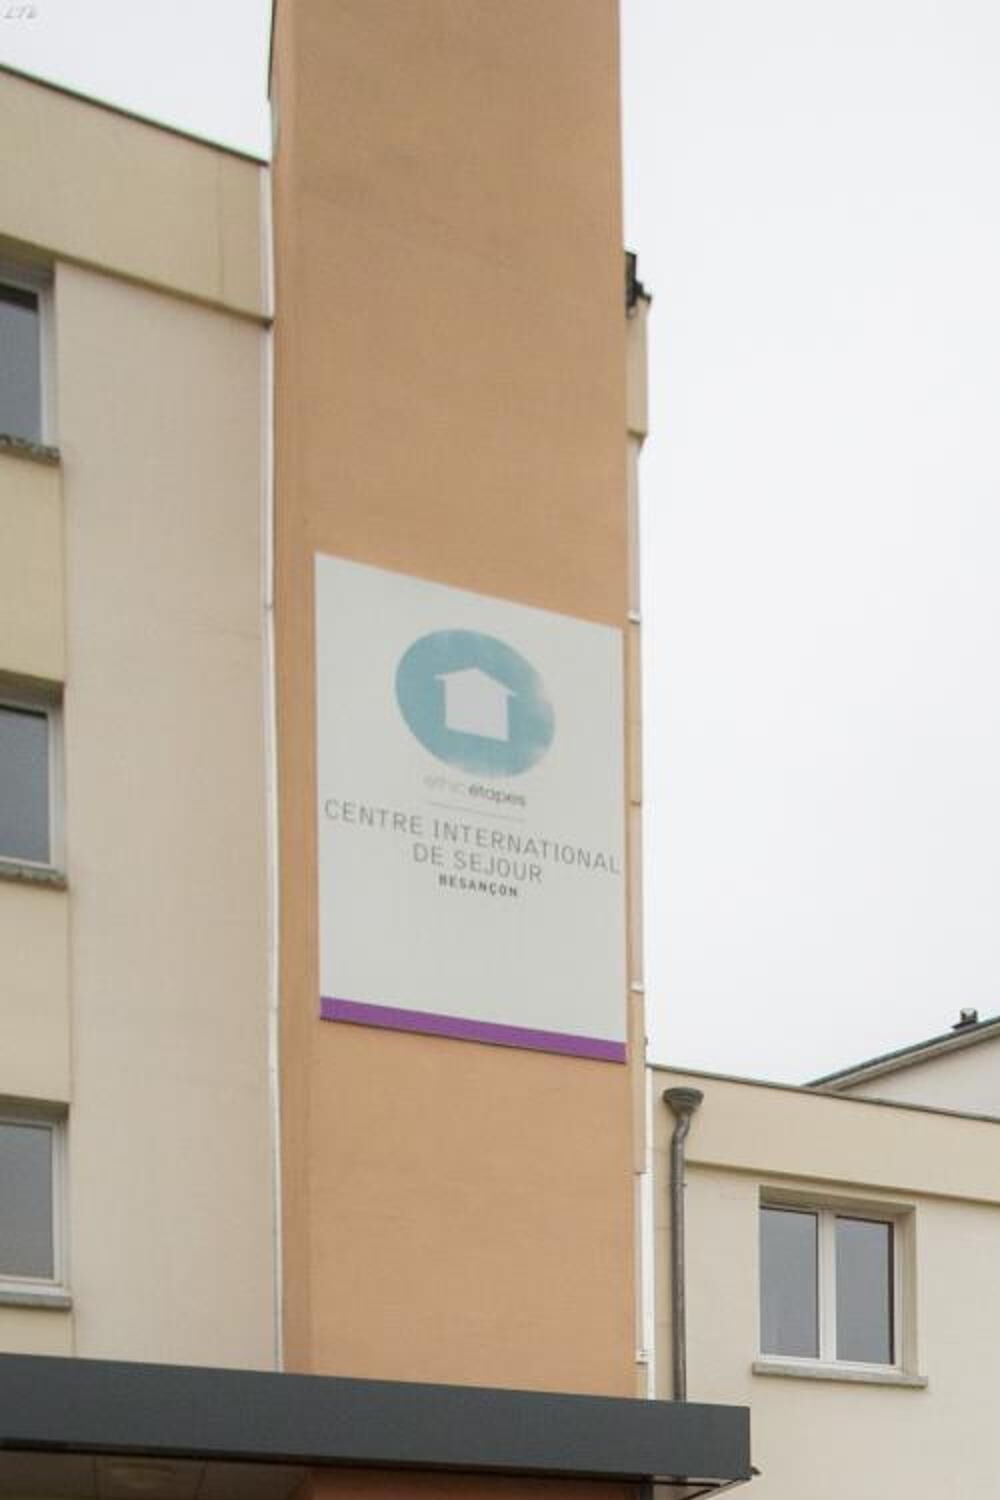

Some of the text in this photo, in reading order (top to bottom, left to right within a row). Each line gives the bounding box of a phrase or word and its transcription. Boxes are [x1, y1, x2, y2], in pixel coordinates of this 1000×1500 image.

[323, 799, 621, 875] CENTRE INTERNATIONAL
[412, 842, 445, 866] DE
